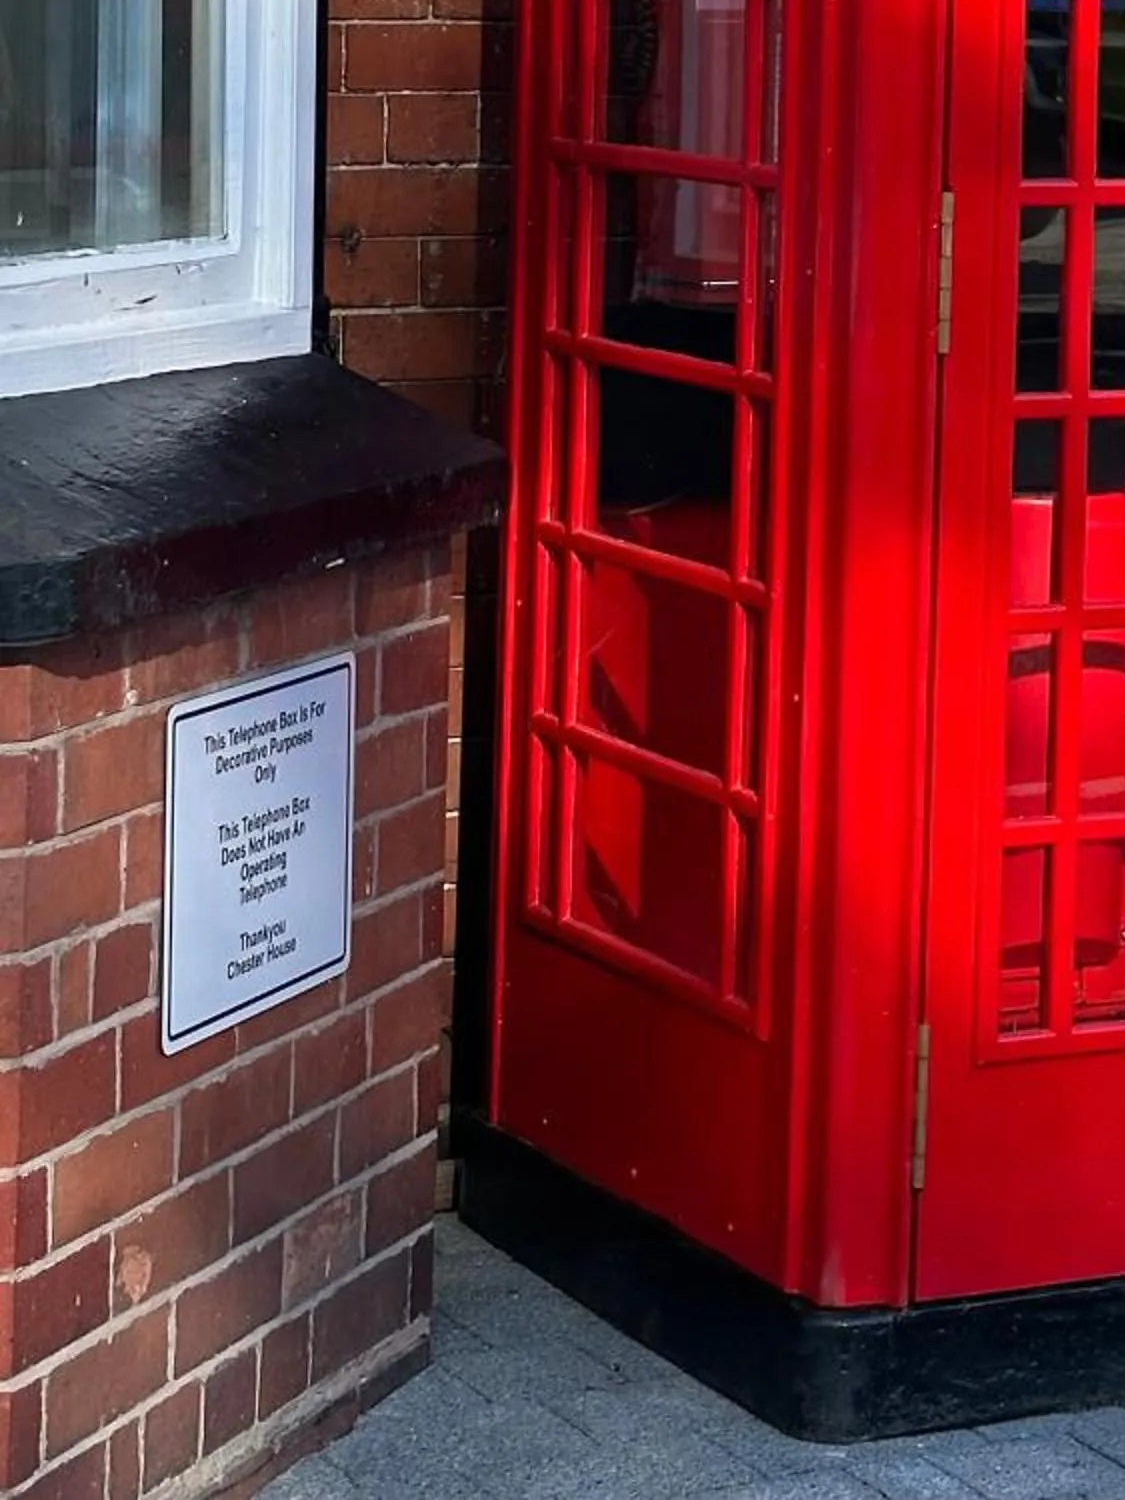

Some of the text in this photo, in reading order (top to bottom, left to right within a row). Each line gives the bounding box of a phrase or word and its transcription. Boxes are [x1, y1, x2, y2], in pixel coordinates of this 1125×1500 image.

[204, 701, 325, 754] This Telephone Box Is For
[215, 729, 313, 775] Decorative Purposes
[254, 762, 276, 783] Only
[218, 797, 310, 844] This Telephone Box
[221, 819, 305, 867] Does Not Have An
[240, 851, 287, 883] Operating
[239, 874, 287, 904] Telephone
[240, 920, 286, 951] Thankyou
[227, 938, 296, 980] Chester House
